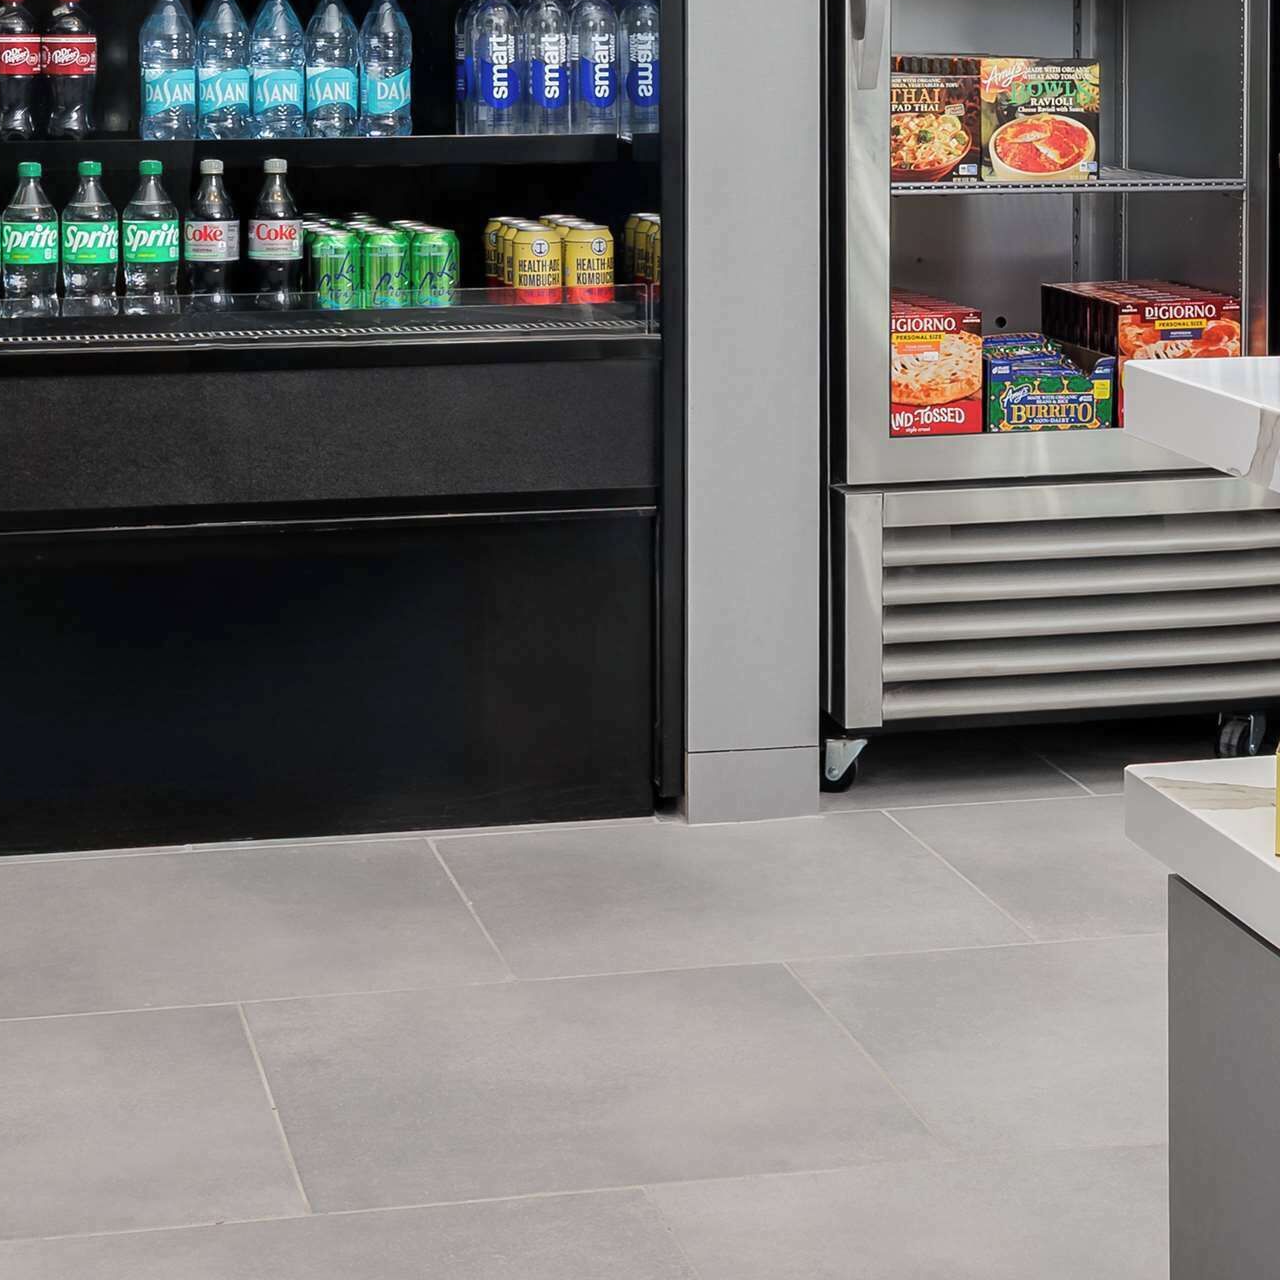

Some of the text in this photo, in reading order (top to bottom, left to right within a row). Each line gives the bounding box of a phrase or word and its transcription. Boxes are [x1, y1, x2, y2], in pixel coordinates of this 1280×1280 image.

[4, 51, 29, 65] Pepper
[12, 48, 22, 56] Dr
[54, 51, 80, 65] Pepper
[63, 48, 73, 56] Dr
[489, 34, 508, 99] smart
[541, 34, 560, 98] smart
[592, 33, 609, 98] smart
[982, 63, 1029, 92] Amy's
[200, 80, 249, 110] DASANI
[892, 88, 941, 103] THAI
[1009, 80, 1094, 105] BOWLS
[892, 103, 939, 112] PAD THAI
[1031, 98, 1073, 106] RAVIOLI
[3, 224, 57, 252] Sprite
[185, 224, 223, 242] Coke
[255, 223, 297, 241] Coke
[519, 272, 560, 286] KOMBUCHA
[1003, 386, 1029, 407] Amy's
[1011, 402, 1093, 423] BURRITO
